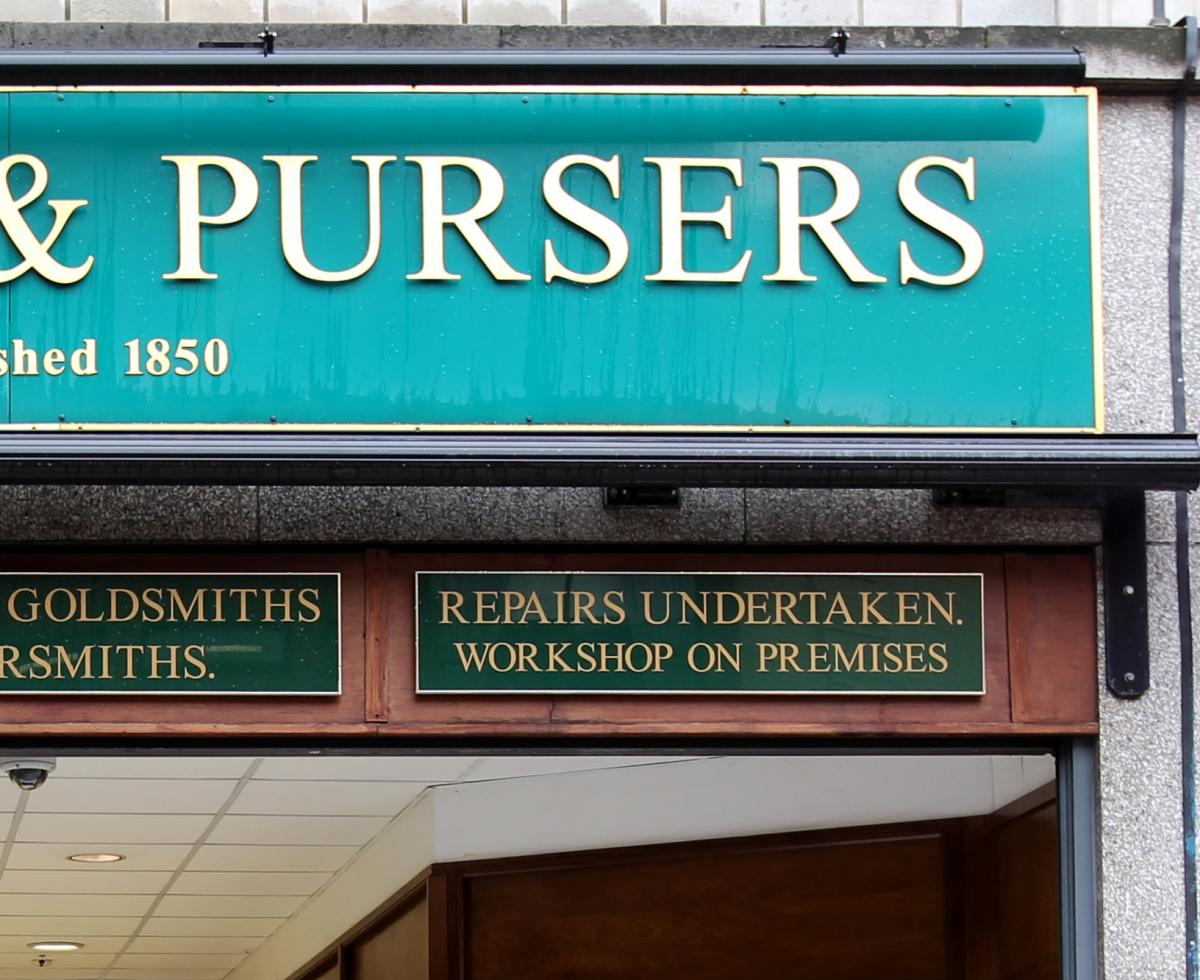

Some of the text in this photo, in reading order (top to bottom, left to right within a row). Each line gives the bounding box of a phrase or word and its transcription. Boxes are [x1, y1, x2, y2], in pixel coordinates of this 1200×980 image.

[161, 153, 986, 286] PURSERS
[124, 338, 231, 376] 1850
[7, 587, 322, 625] GOLDSMITHS
[438, 590, 965, 626] REPAIRS UNDERTAKEN.
[453, 641, 950, 674] WORKSHOP ON PREMISES
